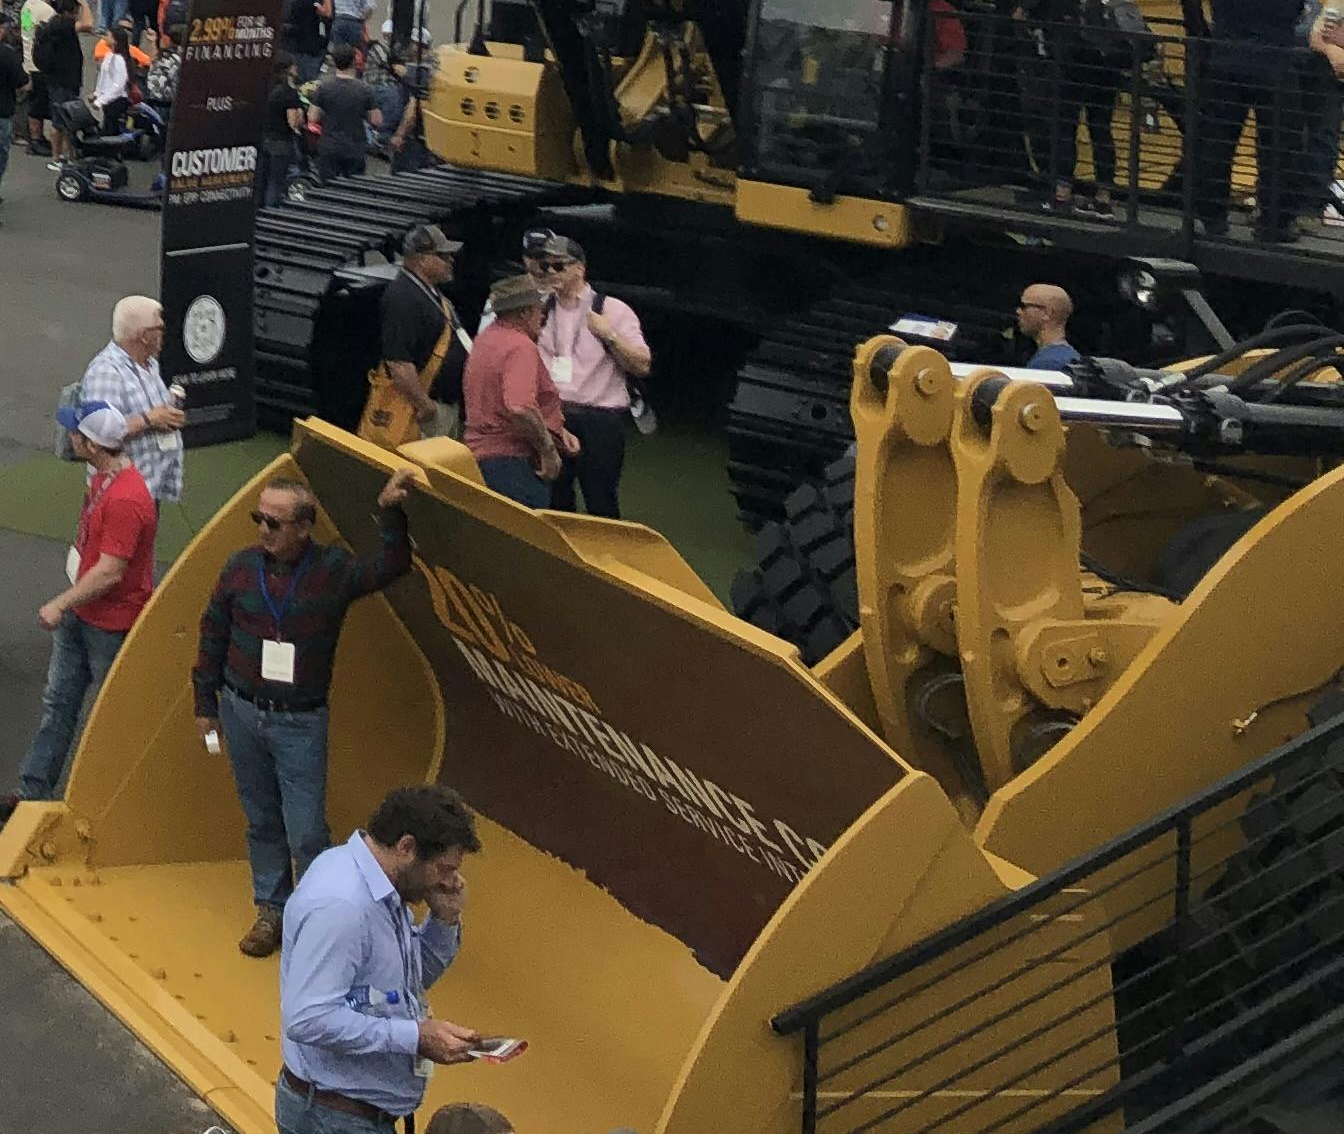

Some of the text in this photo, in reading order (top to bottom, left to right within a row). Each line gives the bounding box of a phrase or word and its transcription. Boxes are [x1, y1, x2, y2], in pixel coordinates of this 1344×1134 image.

[189, 18, 236, 42] 2.99%
[235, 27, 275, 39] MONTHS
[186, 43, 273, 61] FINANCING
[206, 96, 233, 111] PLUS
[172, 146, 257, 177] CUSTOMER
[451, 634, 784, 854] MAINTENANCE
[487, 687, 806, 883] WITH EXTENDED SERVICE INT
